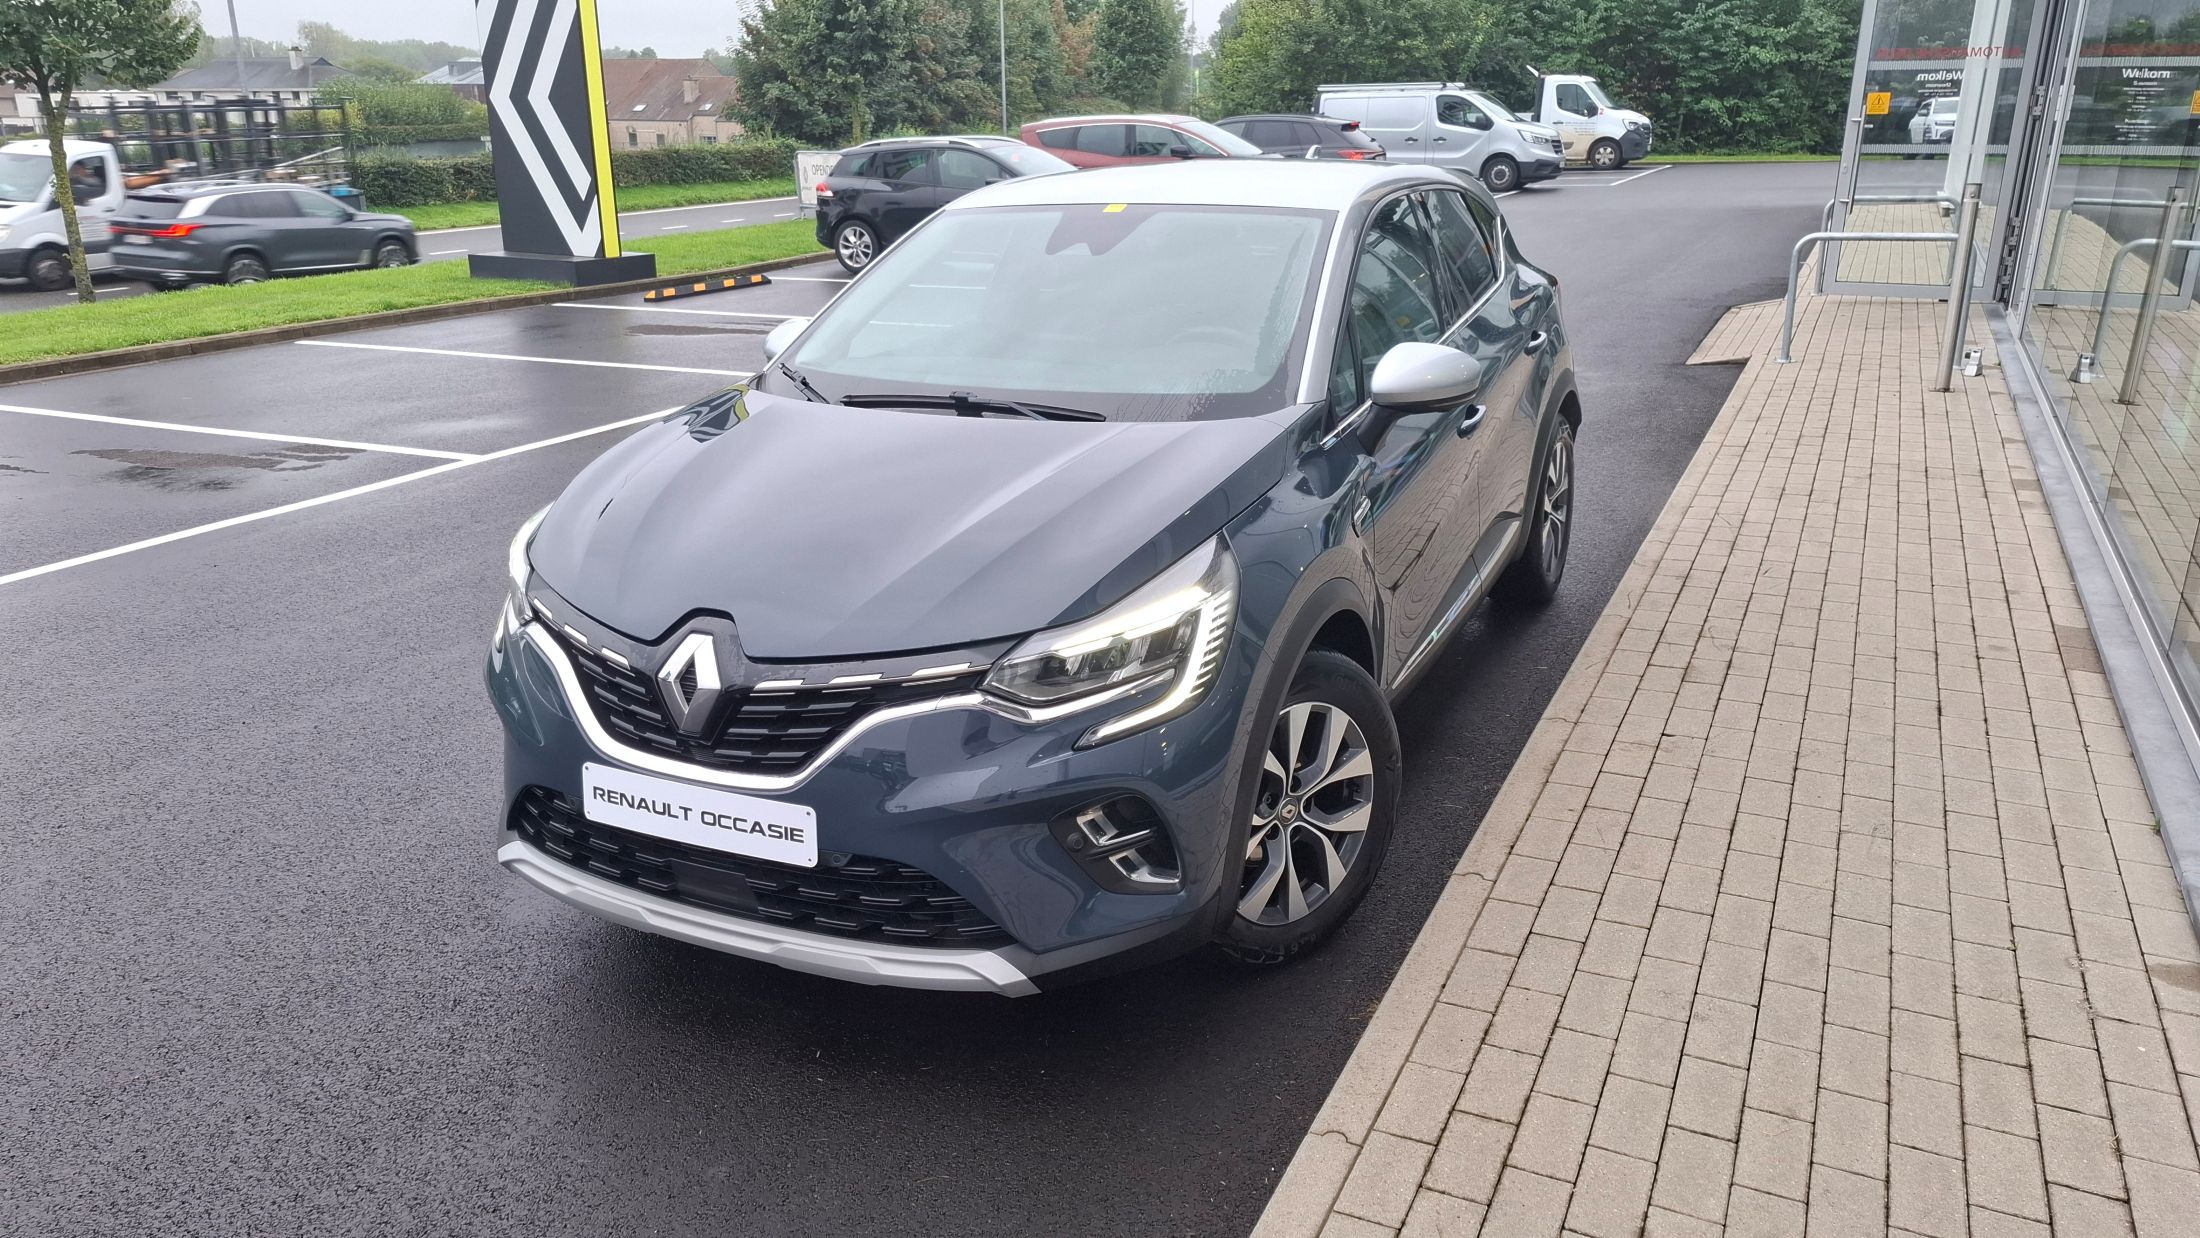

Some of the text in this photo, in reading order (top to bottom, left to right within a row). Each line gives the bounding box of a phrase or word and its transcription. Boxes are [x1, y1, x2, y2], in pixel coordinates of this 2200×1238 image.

[2122, 68, 2171, 79] Welkom
[593, 786, 804, 843] RENAULT OCCASIE
